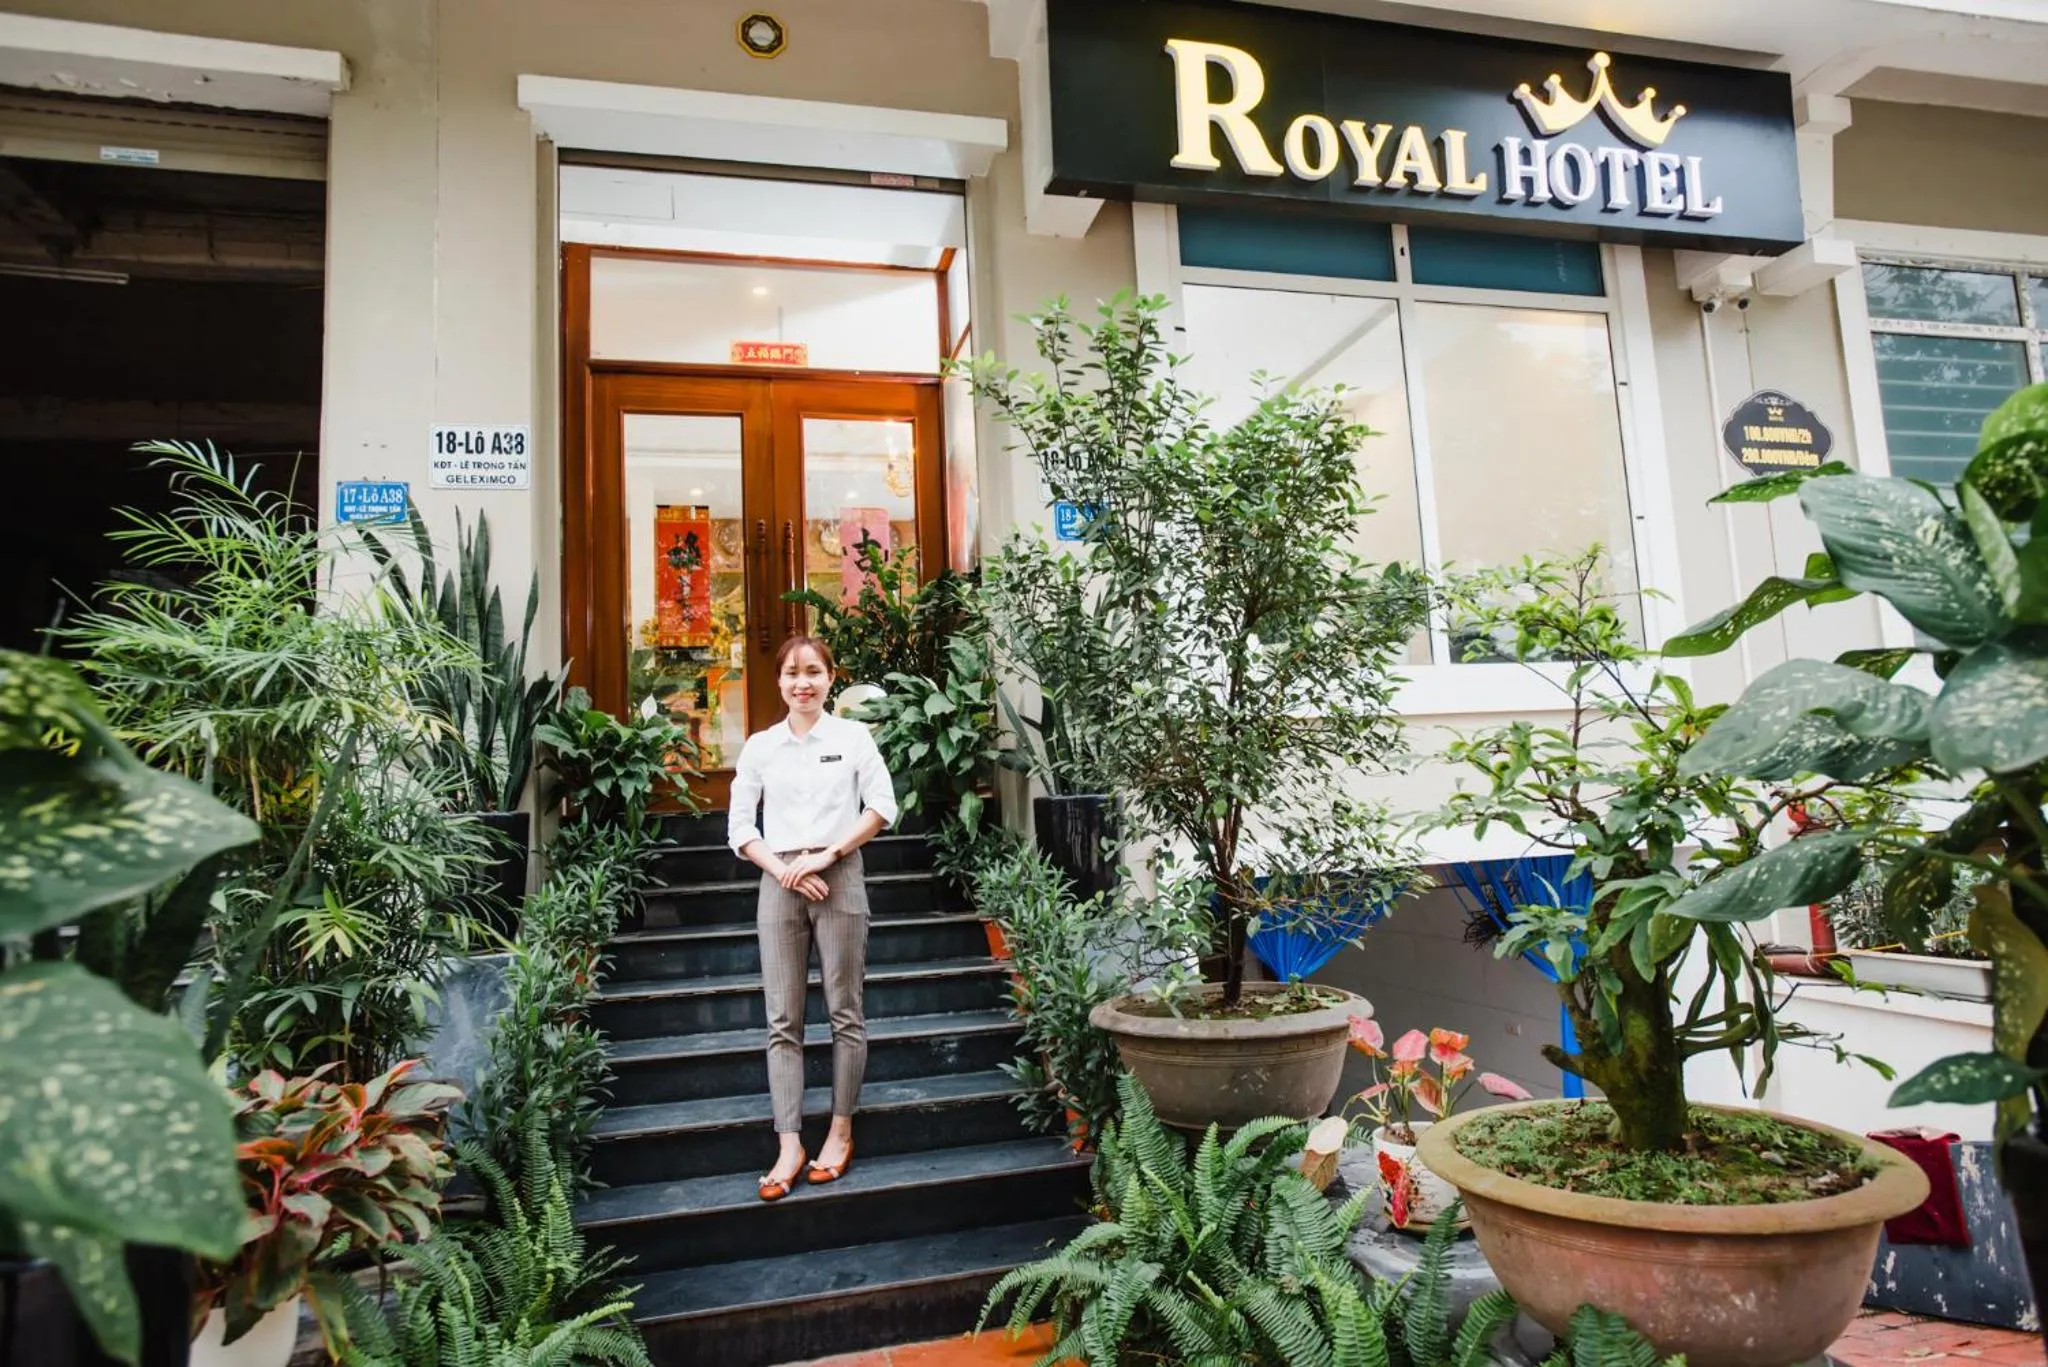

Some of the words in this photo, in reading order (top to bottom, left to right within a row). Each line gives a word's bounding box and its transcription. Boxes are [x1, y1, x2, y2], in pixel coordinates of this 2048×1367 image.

[1164, 38, 1487, 194] ROYAL
[1502, 136, 1722, 218] HOTEL
[435, 431, 485, 454] 18-Lô
[491, 432, 525, 455] A38
[446, 474, 516, 484] GELEXIMCO
[380, 487, 404, 504] A38
